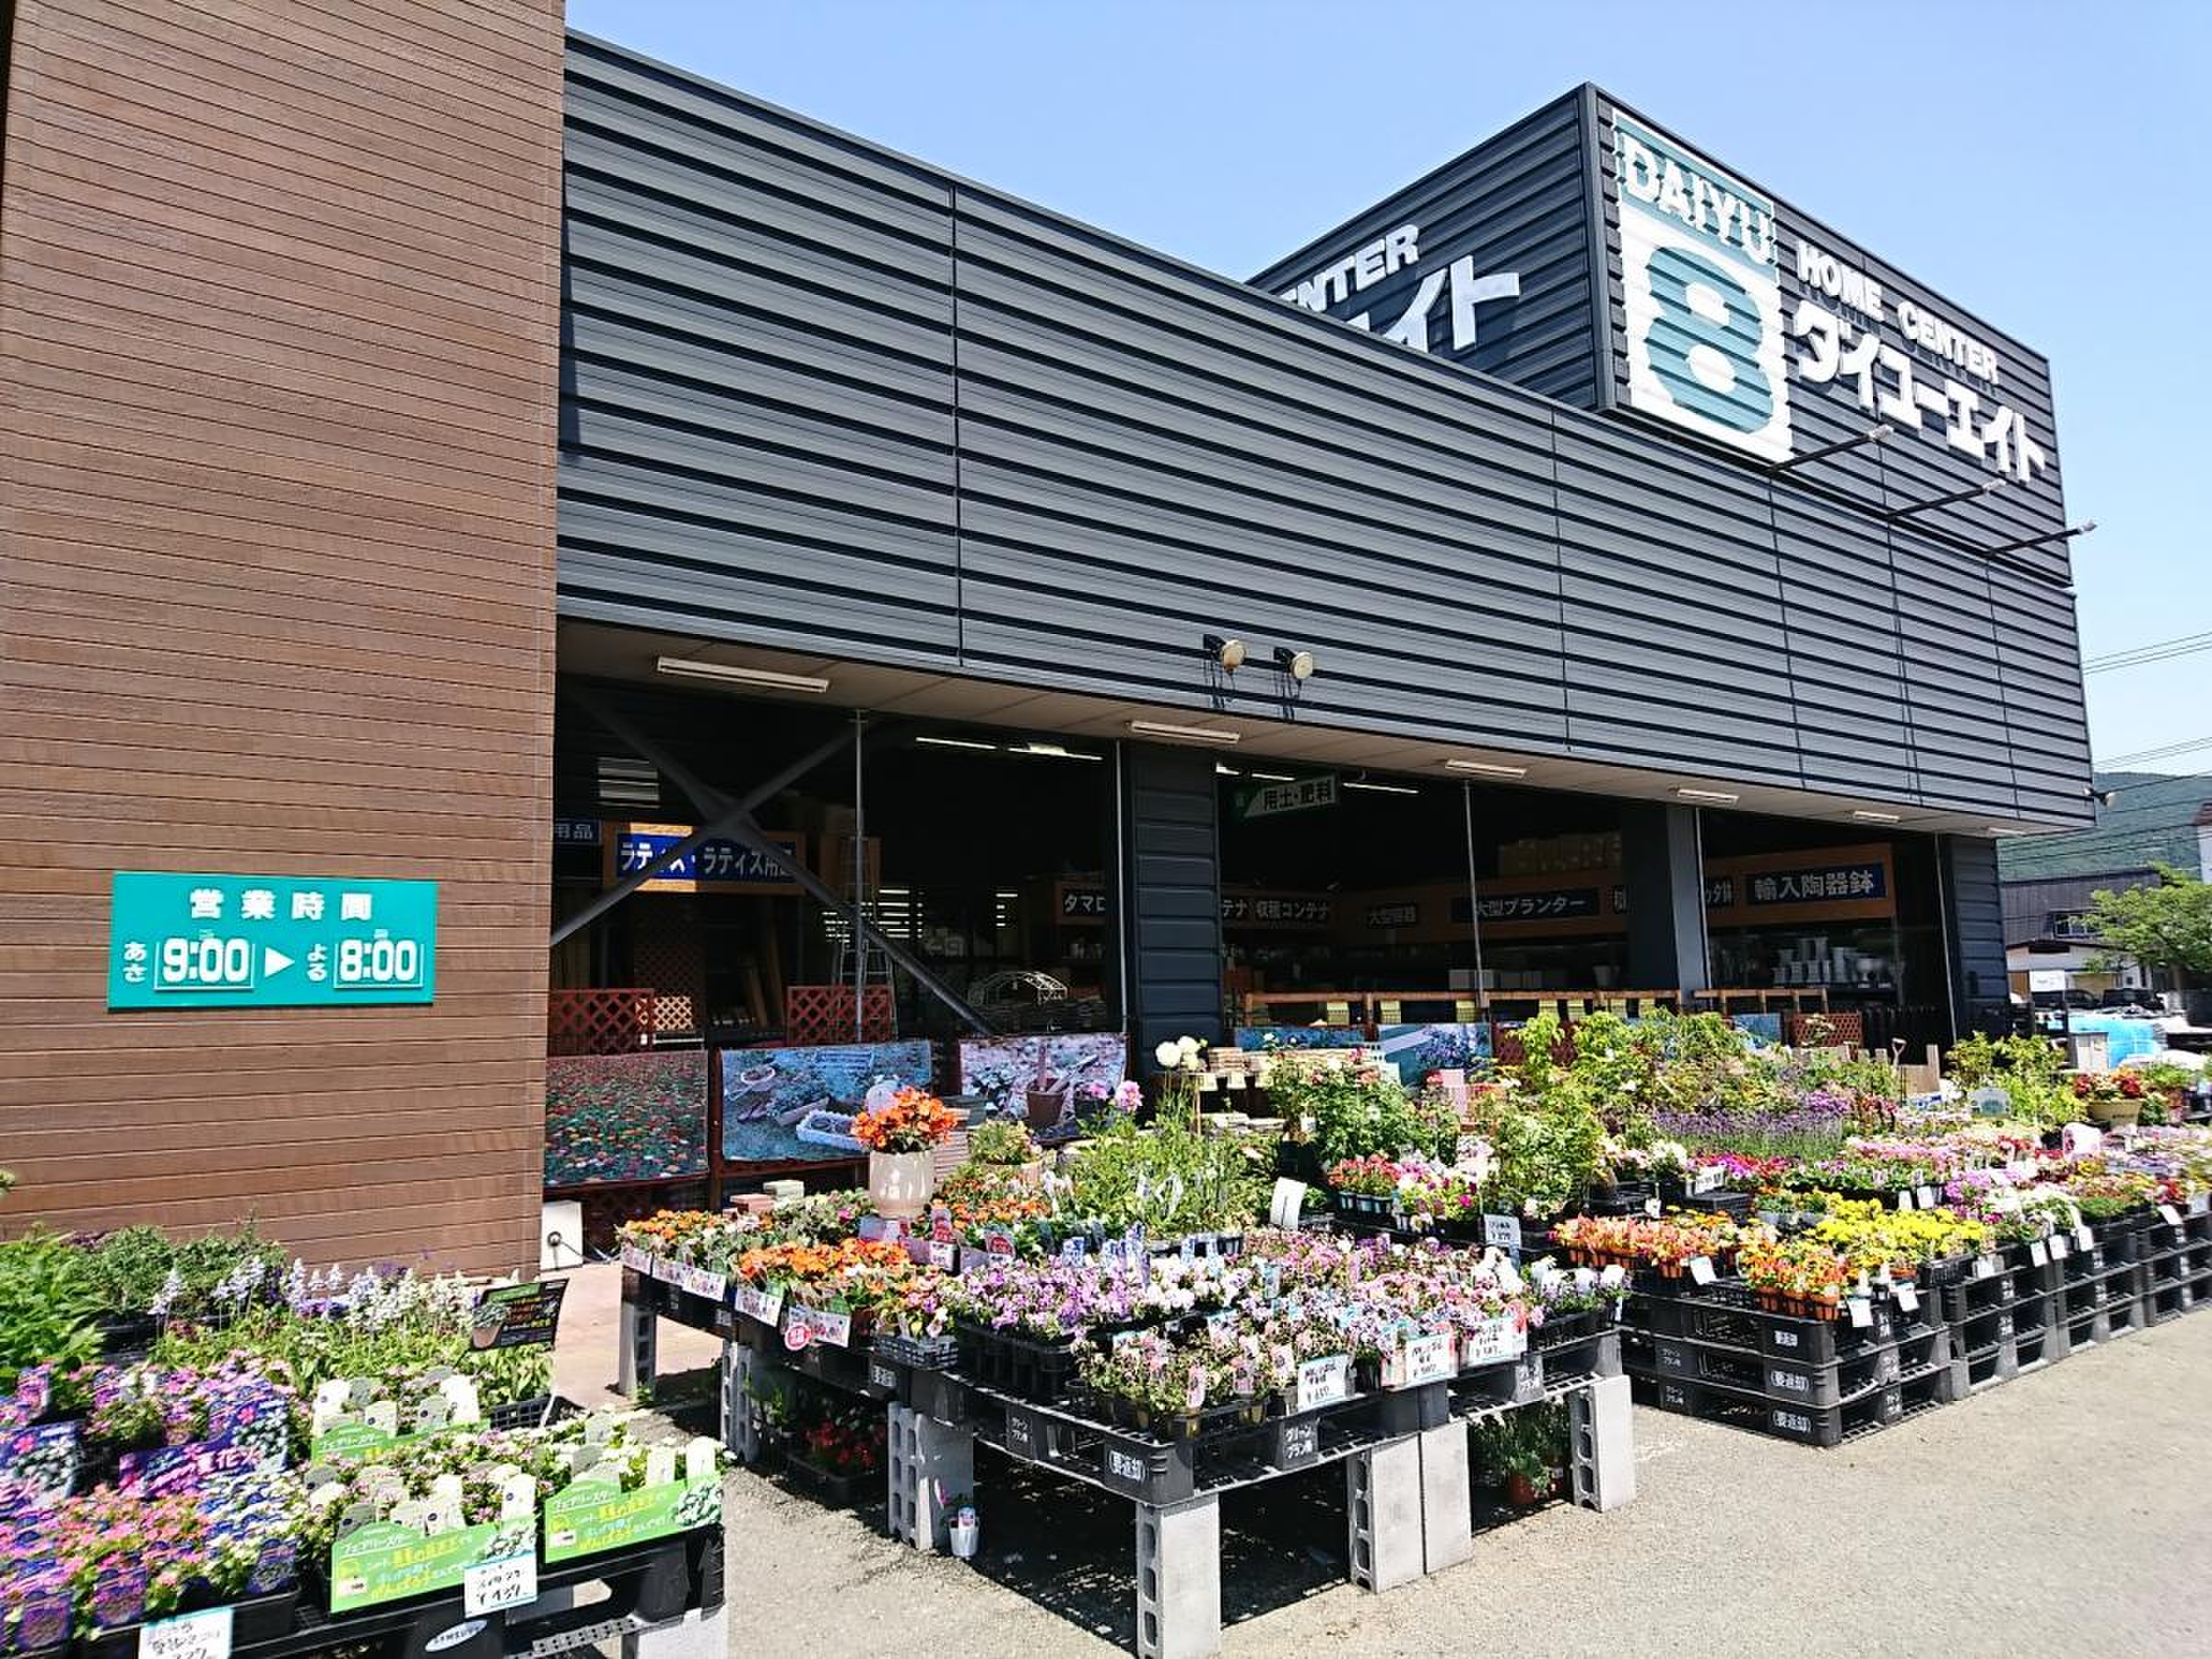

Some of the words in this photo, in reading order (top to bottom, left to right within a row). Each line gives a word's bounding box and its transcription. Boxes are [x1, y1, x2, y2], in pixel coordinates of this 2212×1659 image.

[1622, 134, 1771, 266] DAIYU
[1280, 224, 1419, 312] NTER
[1347, 254, 1519, 353] イト
[1797, 240, 1884, 321] HOME
[1897, 300, 2000, 384] CENTER
[1644, 246, 1774, 434] 8
[1793, 299, 2046, 483] ダイユーエイト
[189, 888, 373, 921] 営業時間
[1754, 869, 1874, 900] 輸入陶器鉢
[124, 941, 147, 982] あさ
[161, 937, 251, 983] 9:00
[307, 944, 328, 982] よる
[338, 938, 418, 982] 8:00
